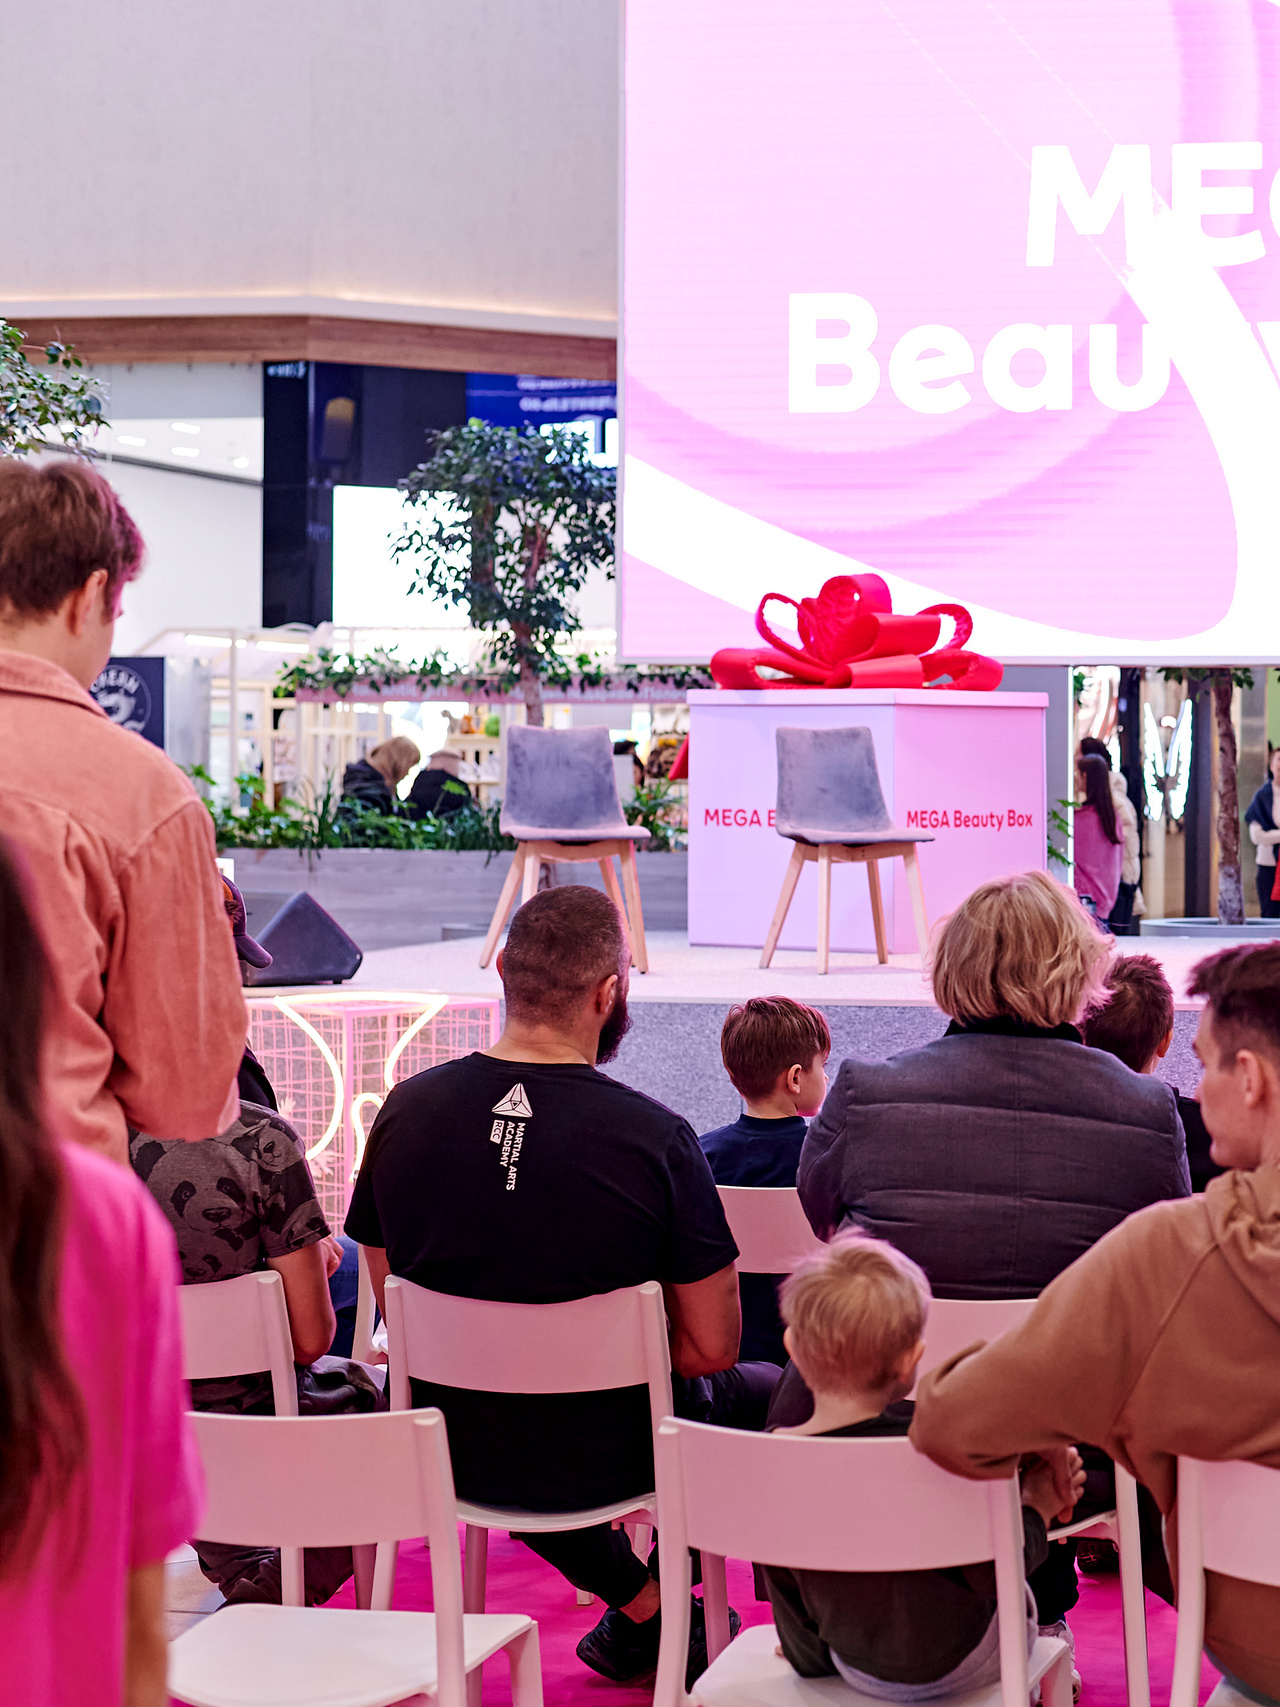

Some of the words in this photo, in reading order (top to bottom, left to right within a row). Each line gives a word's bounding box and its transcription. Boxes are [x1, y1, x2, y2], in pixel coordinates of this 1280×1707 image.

[704, 808, 762, 828] MEGA
[906, 809, 950, 829] MEGA
[953, 809, 1004, 832] Beauty
[1007, 808, 1034, 828] Box
[492, 1121, 503, 1141] RCC
[499, 1120, 516, 1167] ACADEMY
[510, 1122, 526, 1163] MARTIAL
[505, 1165, 518, 1191] ARTS
